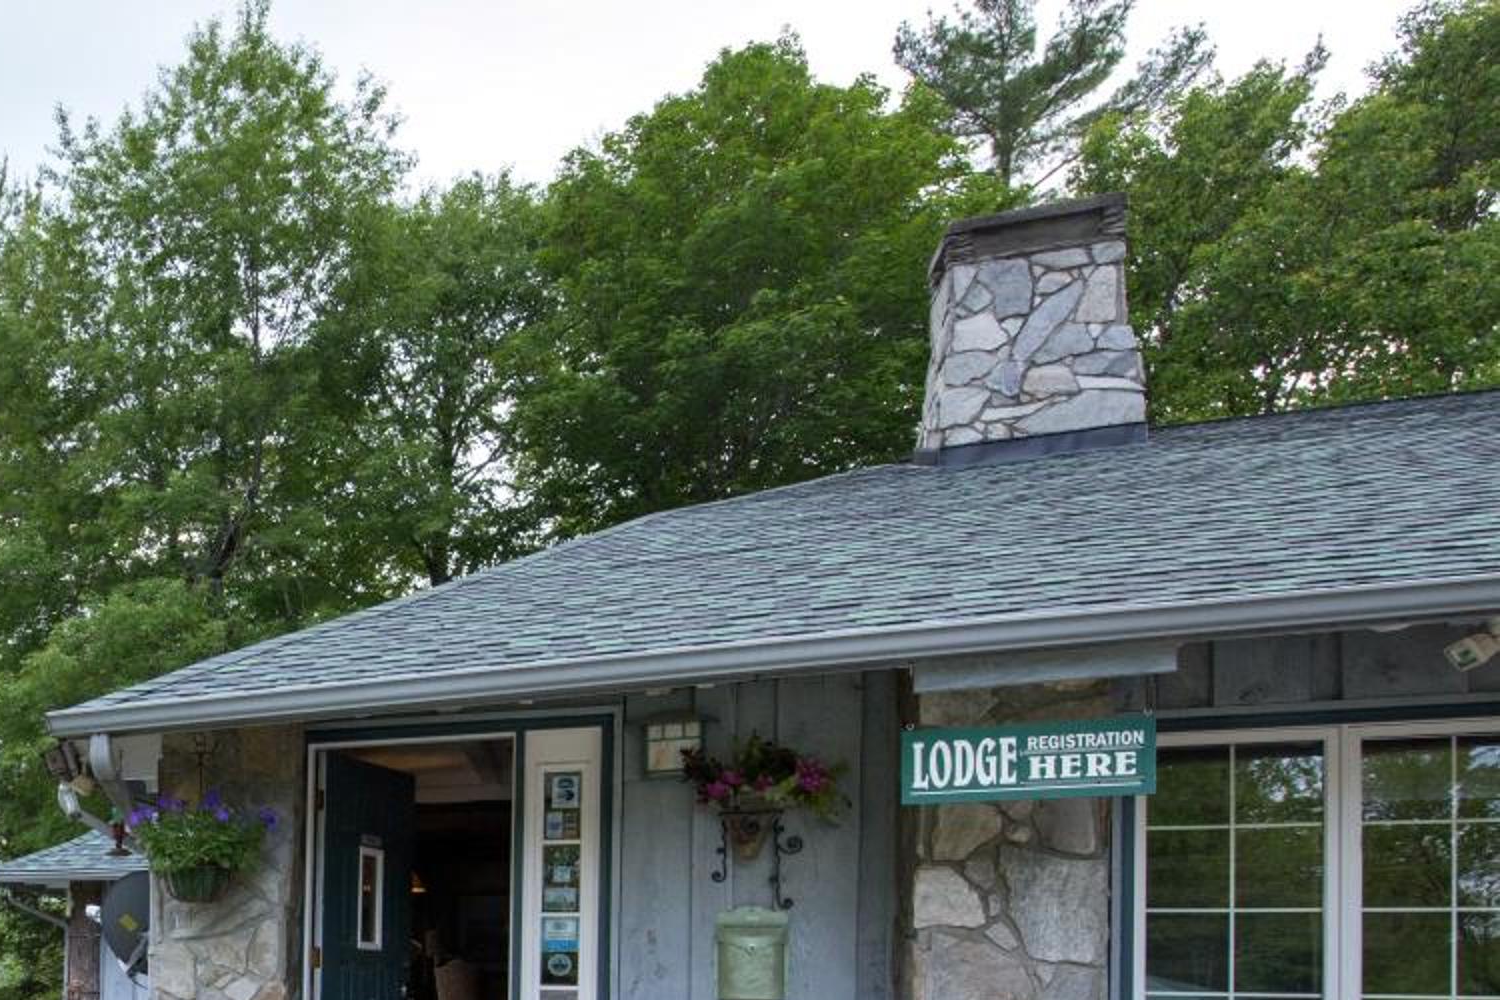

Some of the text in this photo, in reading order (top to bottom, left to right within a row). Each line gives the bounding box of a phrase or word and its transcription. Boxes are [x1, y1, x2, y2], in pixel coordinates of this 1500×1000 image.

[1027, 730, 1145, 749] REGISTRATION
[912, 737, 1017, 789] LODGE
[1028, 752, 1137, 779] HERE
